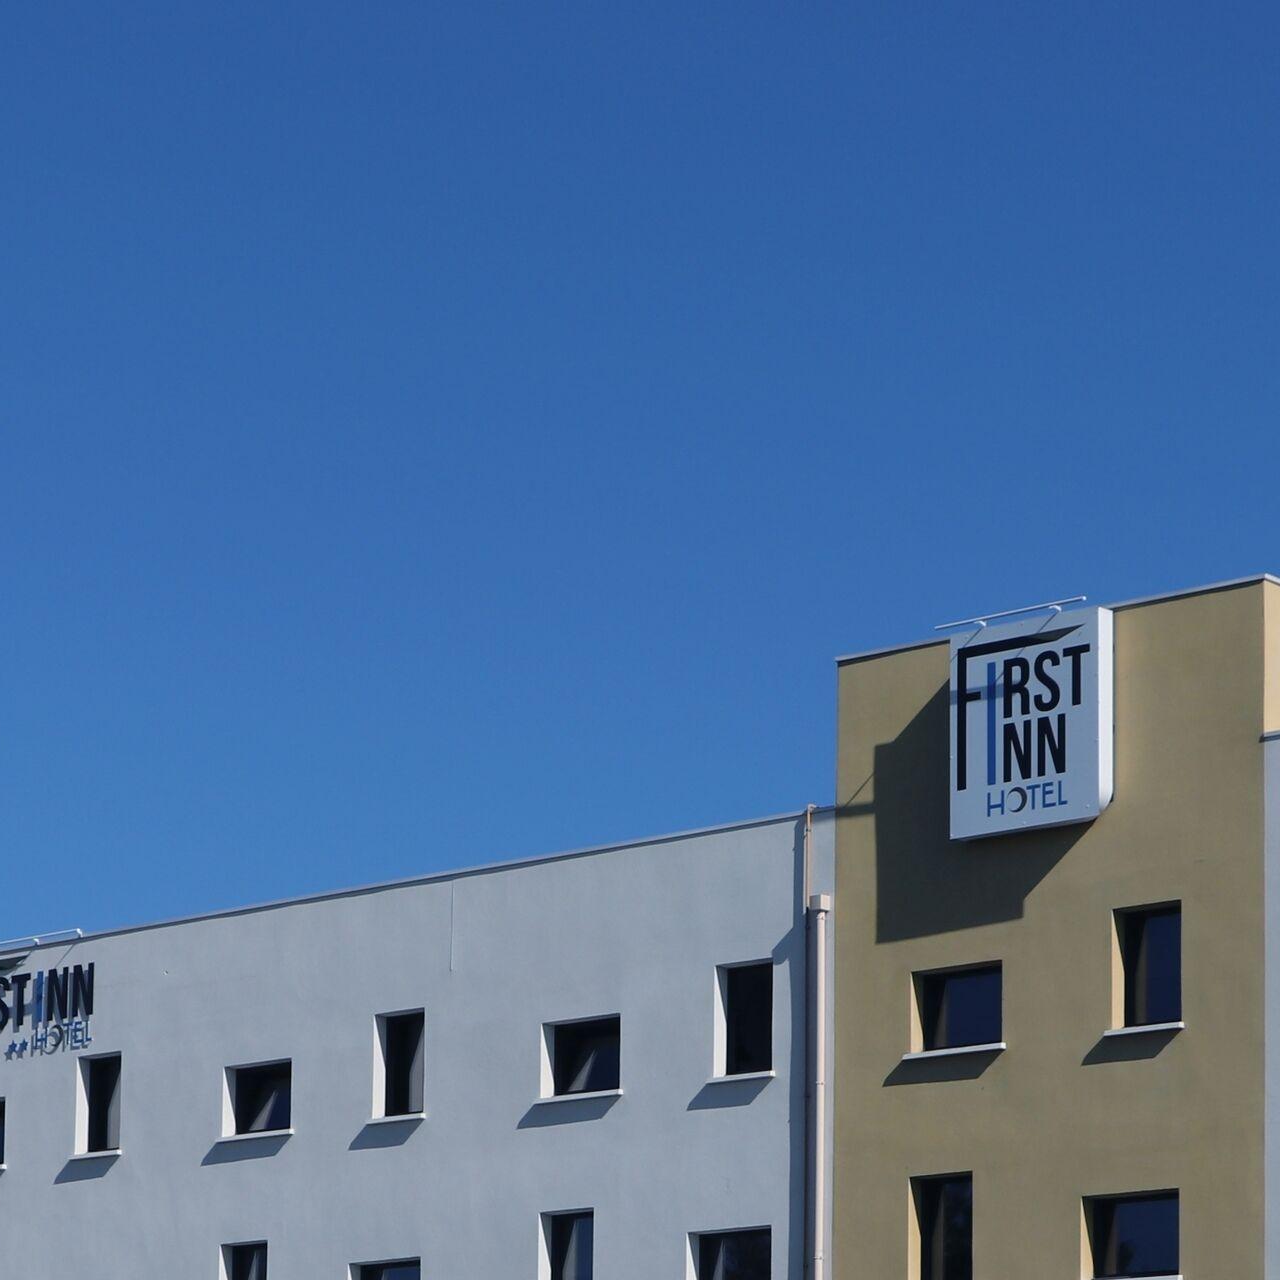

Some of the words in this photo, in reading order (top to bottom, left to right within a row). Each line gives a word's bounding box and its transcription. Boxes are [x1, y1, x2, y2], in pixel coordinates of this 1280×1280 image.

[957, 624, 1090, 791] FIRST
[987, 781, 1067, 817] HOTEL
[35, 963, 95, 1023] INN
[35, 1021, 92, 1049] HOTEL
